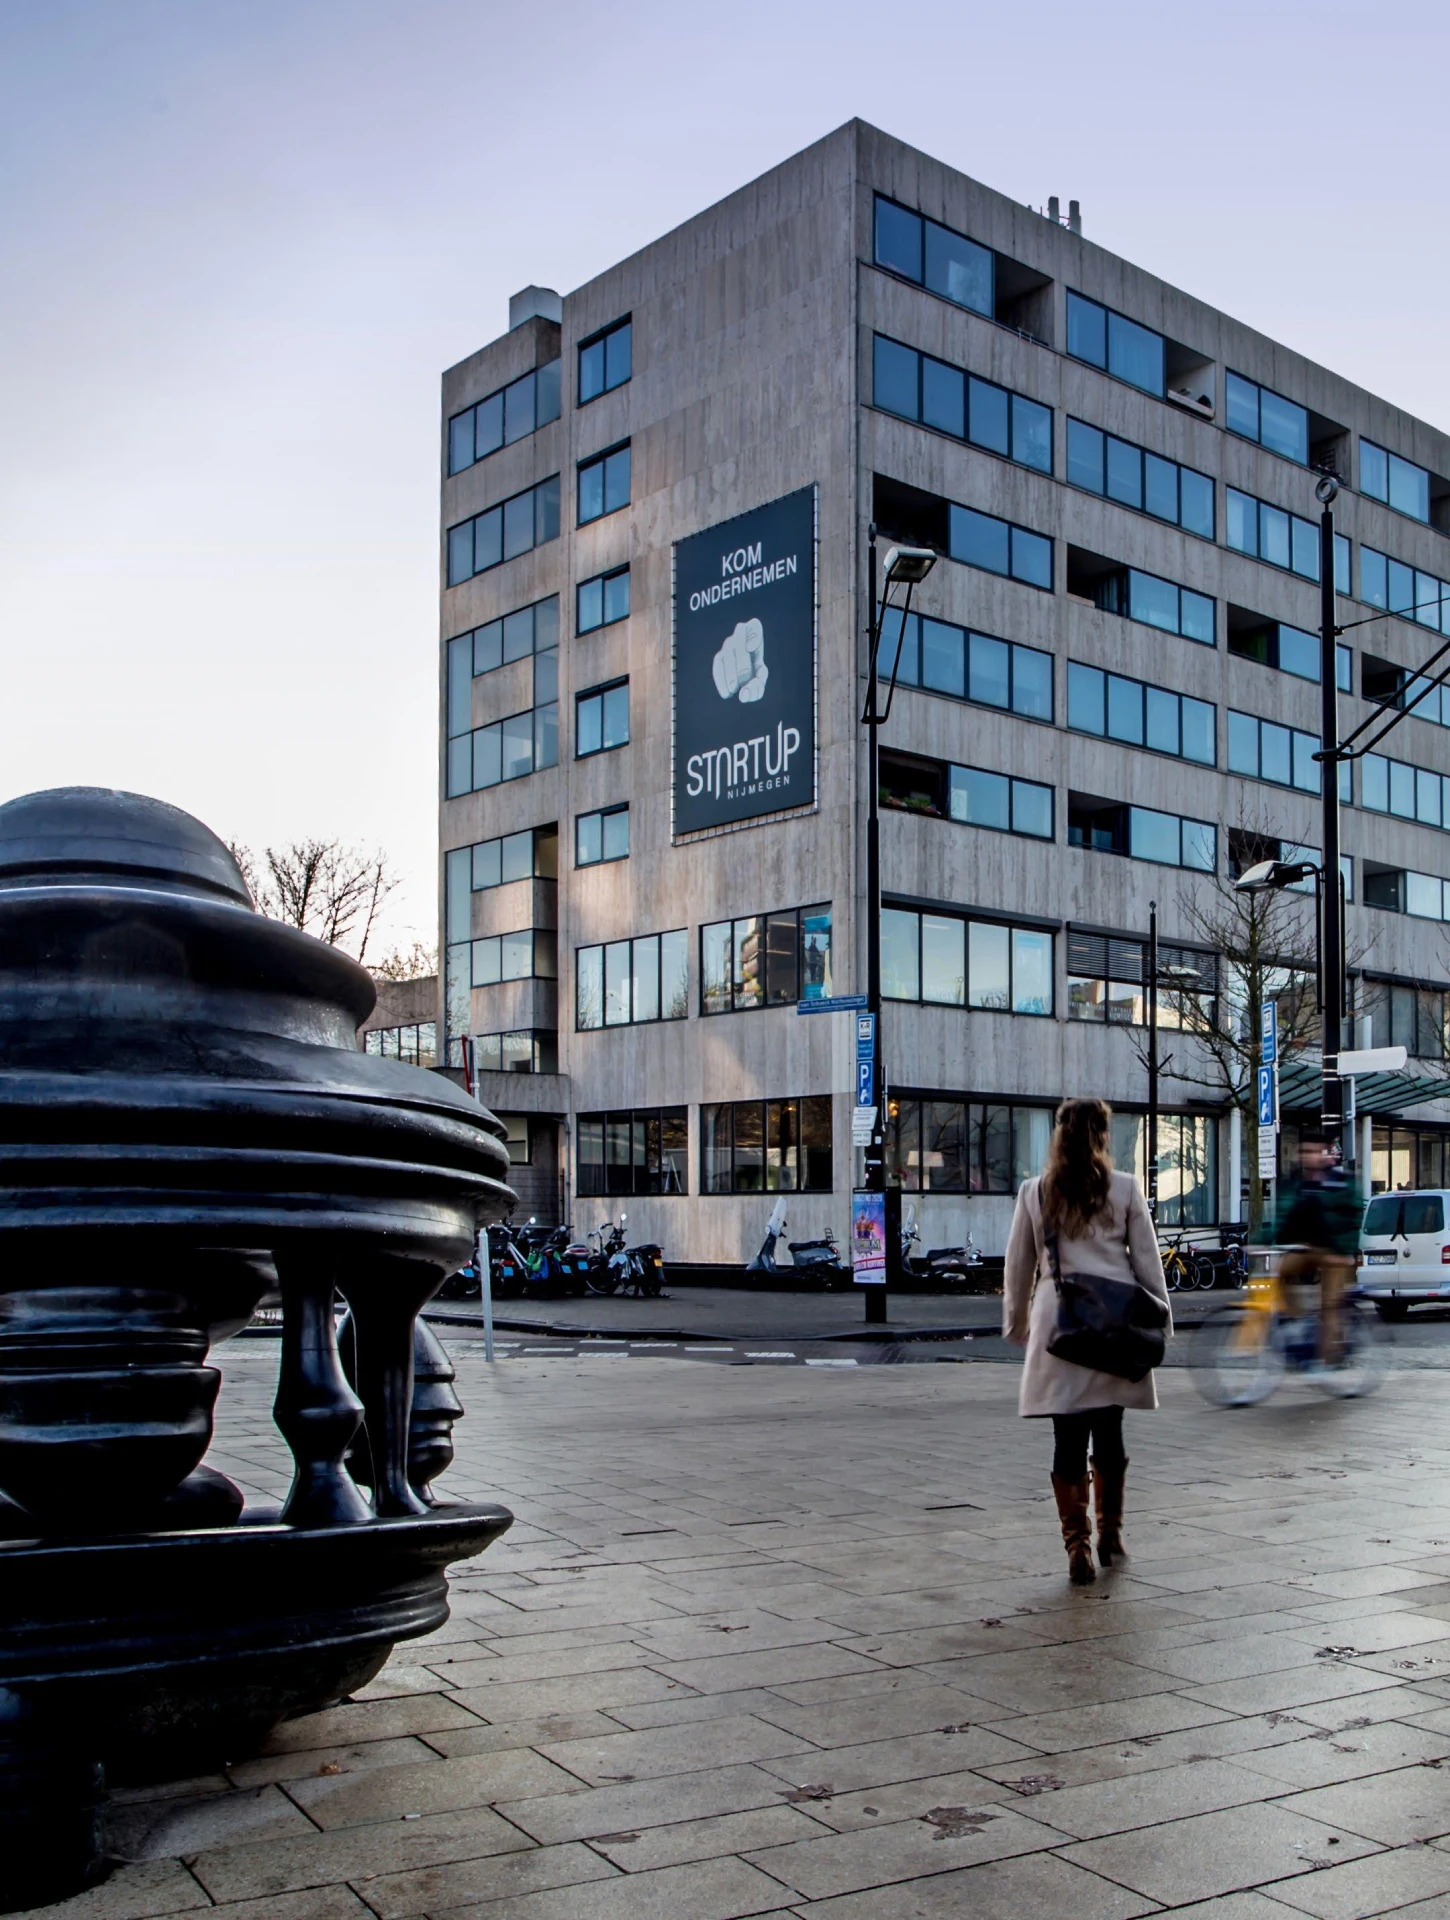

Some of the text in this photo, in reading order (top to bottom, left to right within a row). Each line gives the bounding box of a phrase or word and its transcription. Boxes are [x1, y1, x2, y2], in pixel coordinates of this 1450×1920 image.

[722, 541, 762, 577] KOM
[689, 554, 797, 611] ONDERNEMEN
[686, 720, 800, 800] STARTUP
[727, 775, 790, 799] NIJMEGEN
[860, 1064, 869, 1088] P
[1261, 1071, 1269, 1101] P
